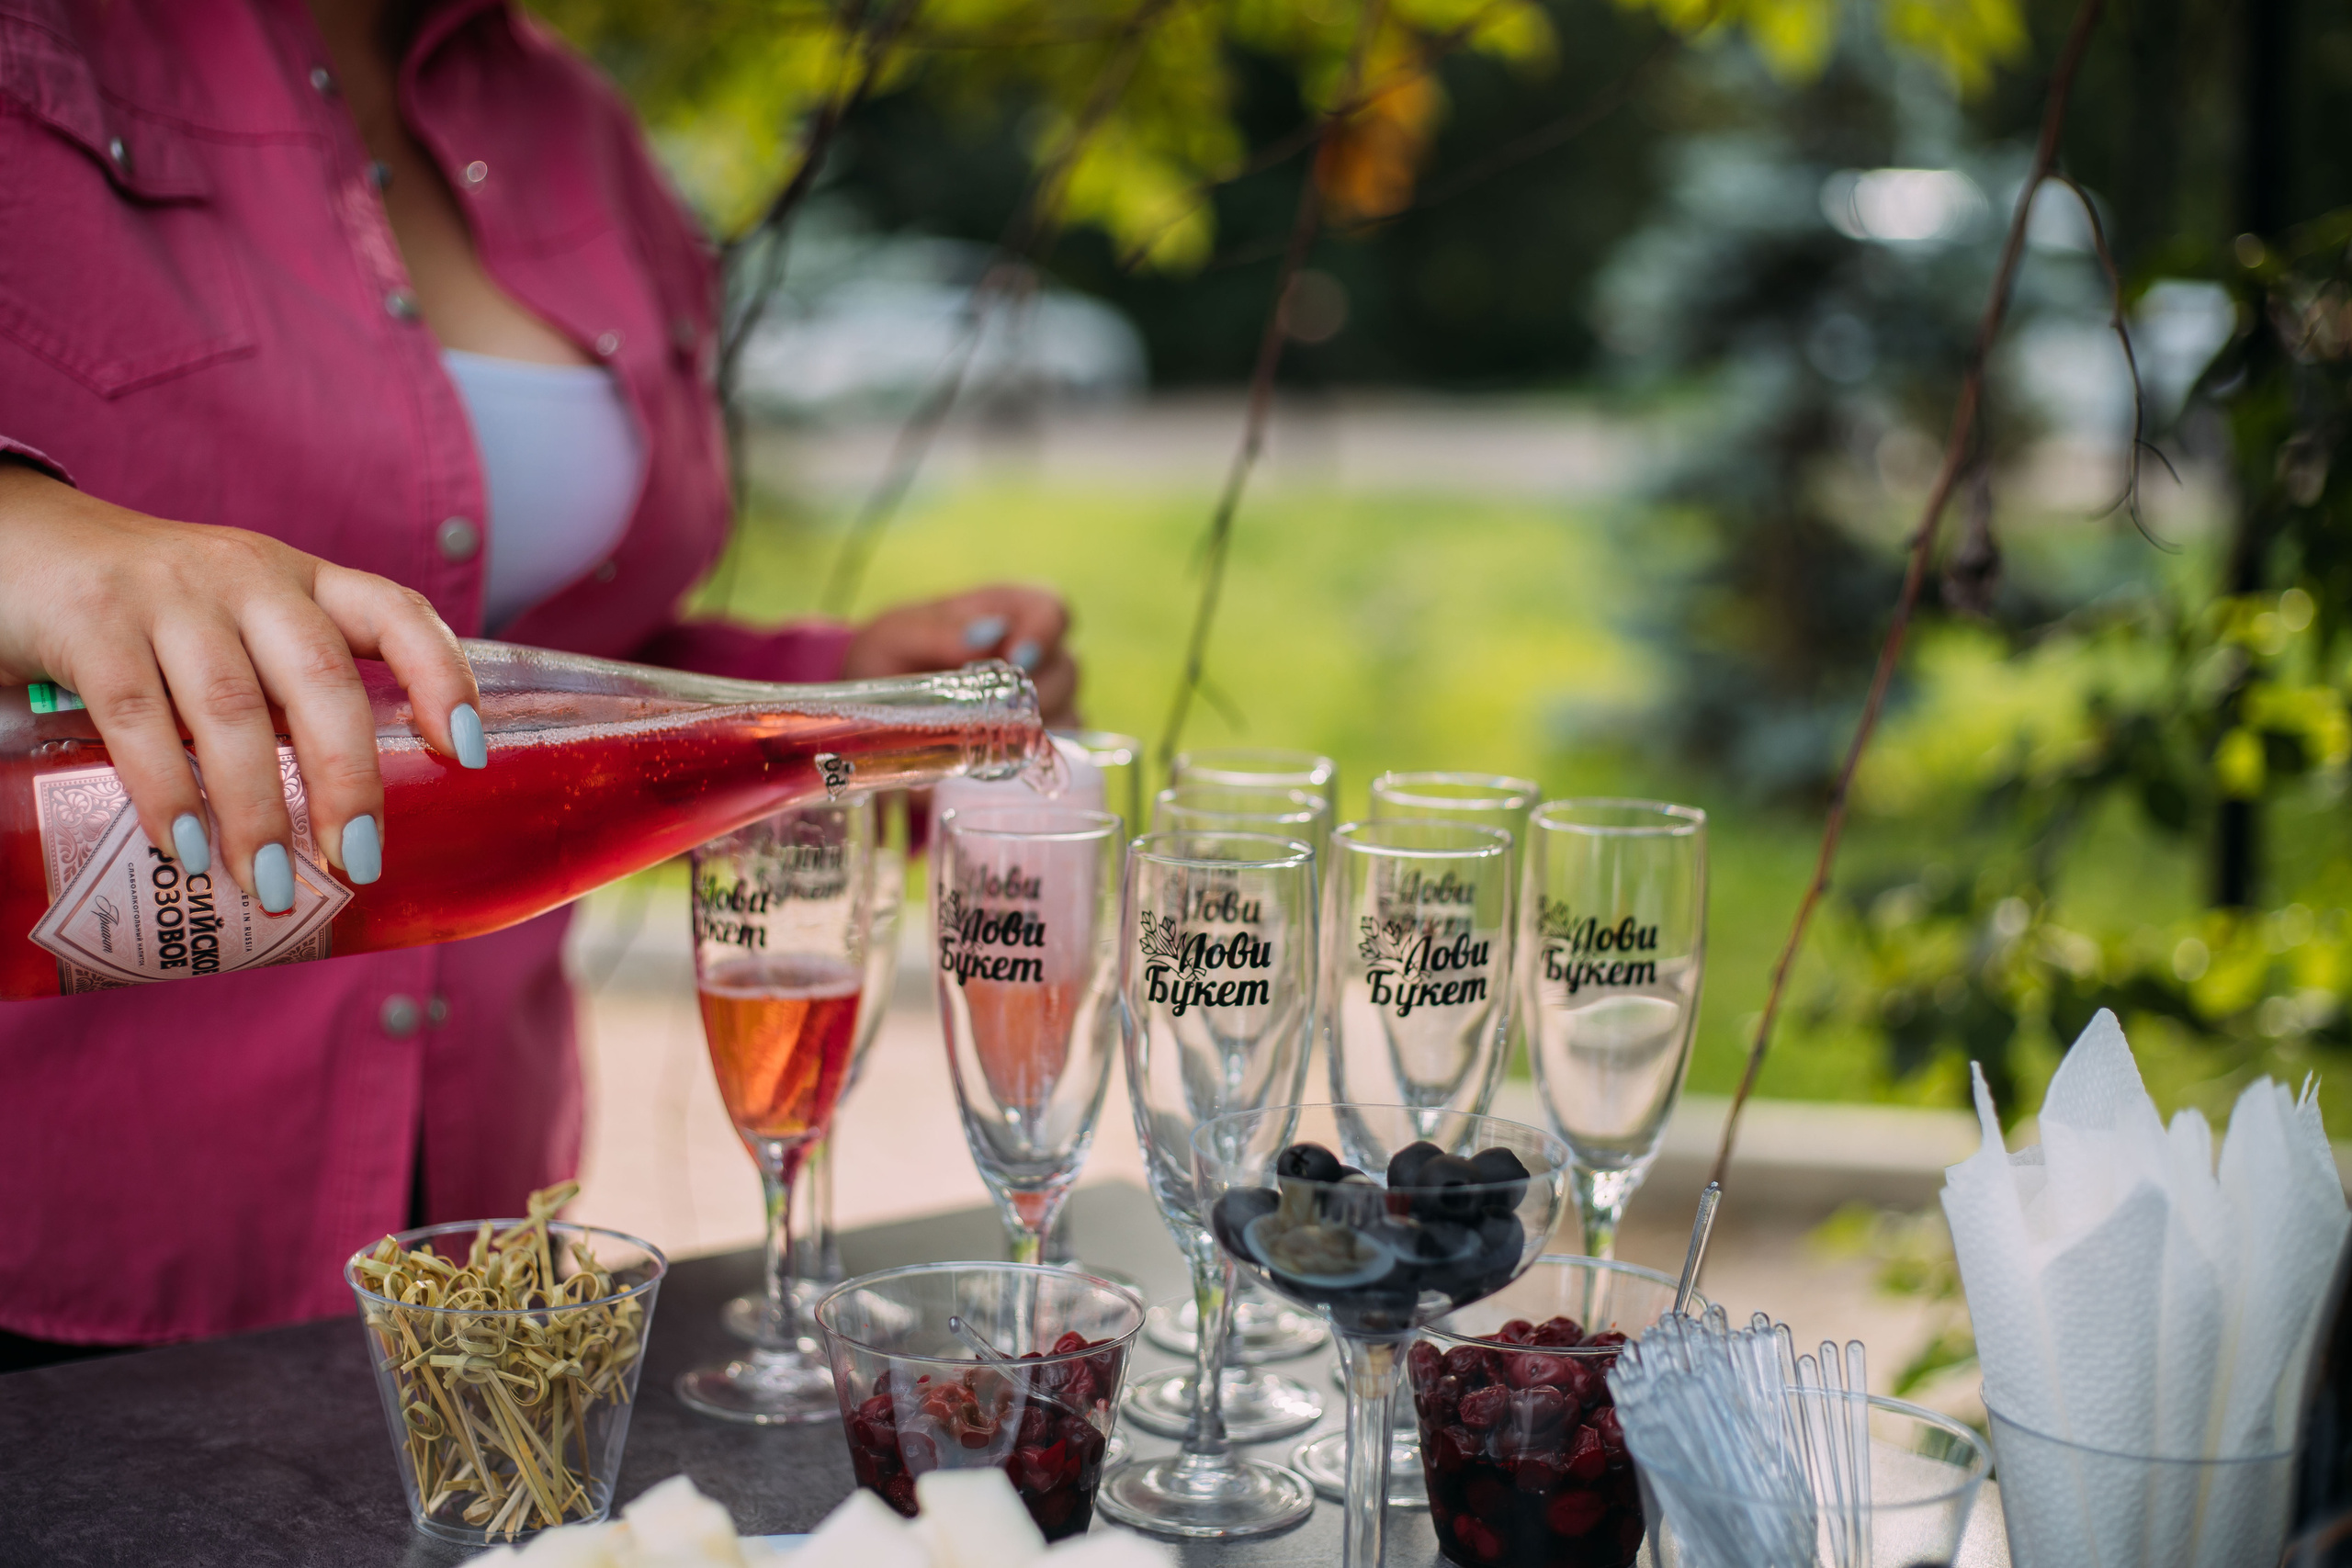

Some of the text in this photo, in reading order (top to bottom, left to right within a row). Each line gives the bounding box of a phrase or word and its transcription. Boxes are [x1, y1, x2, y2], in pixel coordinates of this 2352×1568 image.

[128, 862, 145, 966] СЛАБОАЛКОГОЛЬНЫЙ НАПИТОК
[186, 873, 225, 976] СИЙСКОЕ
[243, 912, 251, 922] IN
[960, 908, 1046, 948] Лови
[1571, 916, 1658, 954] Лови
[244, 926, 253, 953] RUSSIA
[939, 935, 1044, 987] Букет
[1178, 931, 1272, 974] Лови
[1404, 932, 1489, 976] Лови
[1145, 964, 1271, 1018] Букет
[1541, 943, 1657, 994] Букет
[1366, 969, 1487, 1018] Букет
